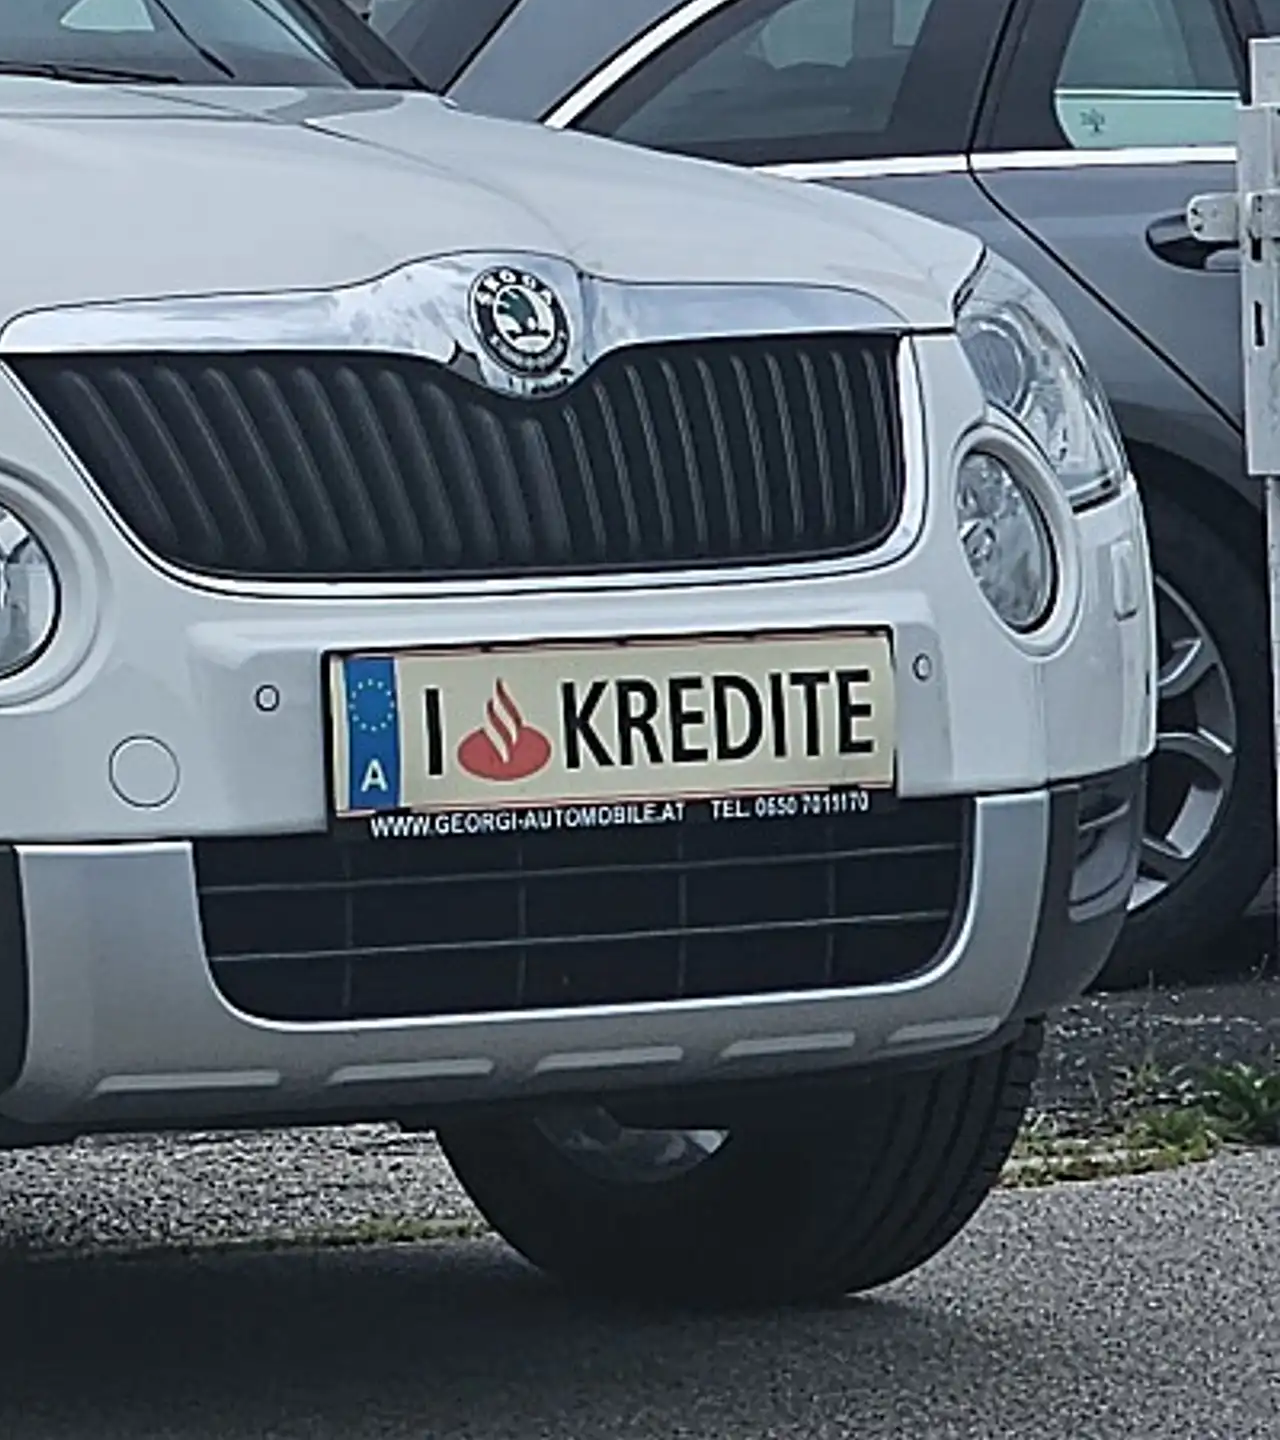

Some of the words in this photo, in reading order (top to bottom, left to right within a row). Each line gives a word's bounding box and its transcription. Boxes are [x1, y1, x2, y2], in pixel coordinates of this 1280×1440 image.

[424, 687, 444, 776] I
[560, 668, 874, 770] KREDITE
[359, 758, 389, 793] A
